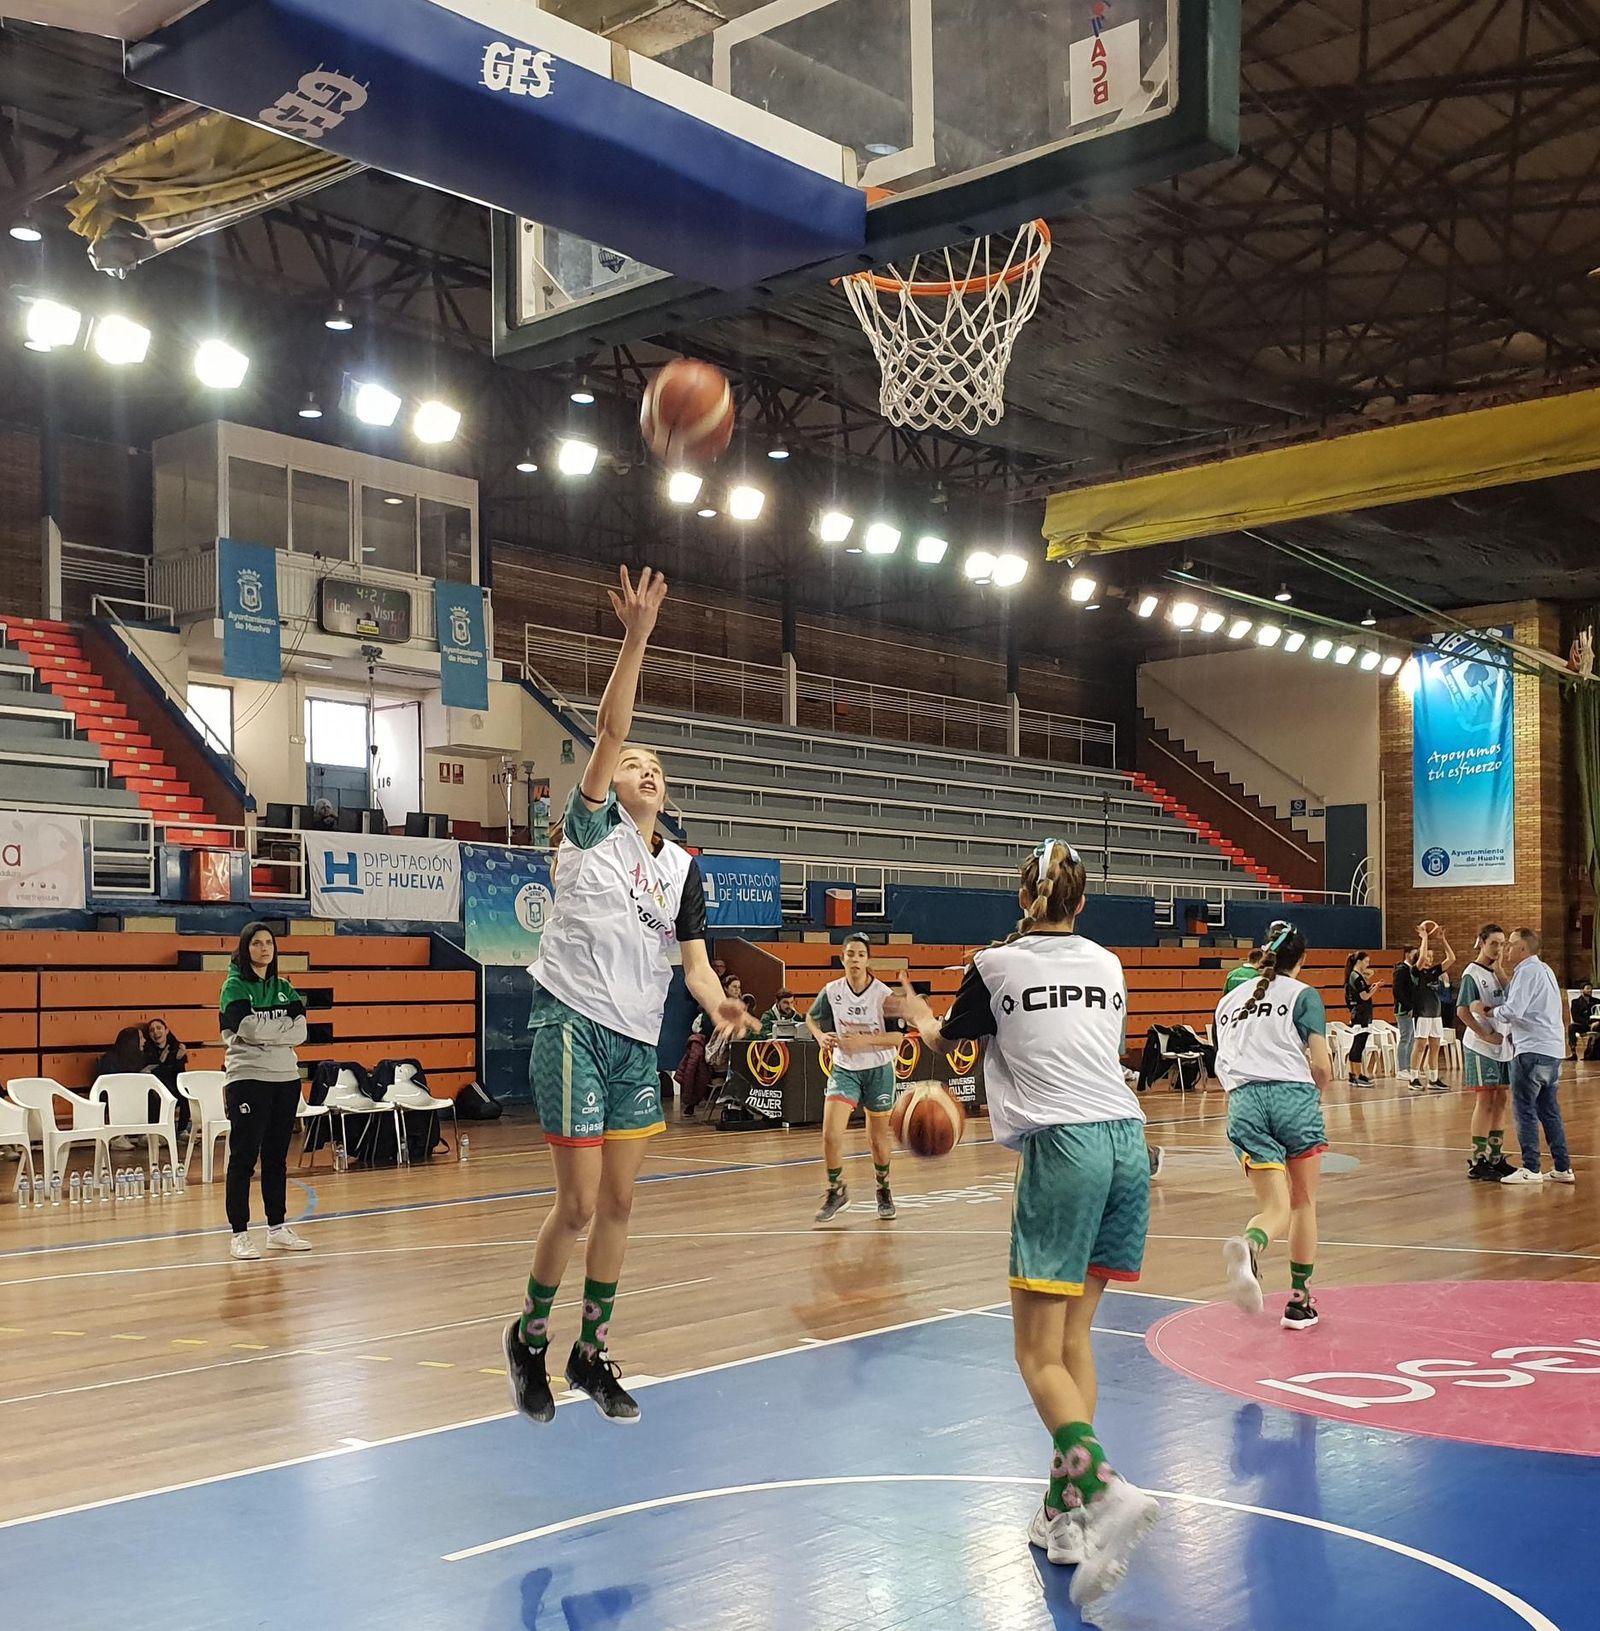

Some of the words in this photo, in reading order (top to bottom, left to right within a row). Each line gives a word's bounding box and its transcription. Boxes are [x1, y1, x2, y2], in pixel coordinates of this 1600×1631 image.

[480, 41, 556, 98] GES
[258, 68, 368, 138] GES
[228, 611, 277, 626] Ayuntamiento
[245, 622, 271, 634] Huelva
[1427, 743, 1502, 771] Apoyamos
[1428, 769, 1445, 781] tu
[1448, 760, 1503, 784] esfuerzo
[1451, 848, 1505, 857] Ayuntamiento
[363, 852, 453, 873] DIPUTACIÓN
[364, 871, 384, 888] DE
[388, 872, 445, 891] HUELVA
[716, 872, 778, 888] DIPUTACIÓN
[719, 888, 733, 901] DE
[736, 888, 773, 903] HUELVA
[847, 1006, 868, 1016] SOY
[745, 1095, 783, 1110] MUJER
